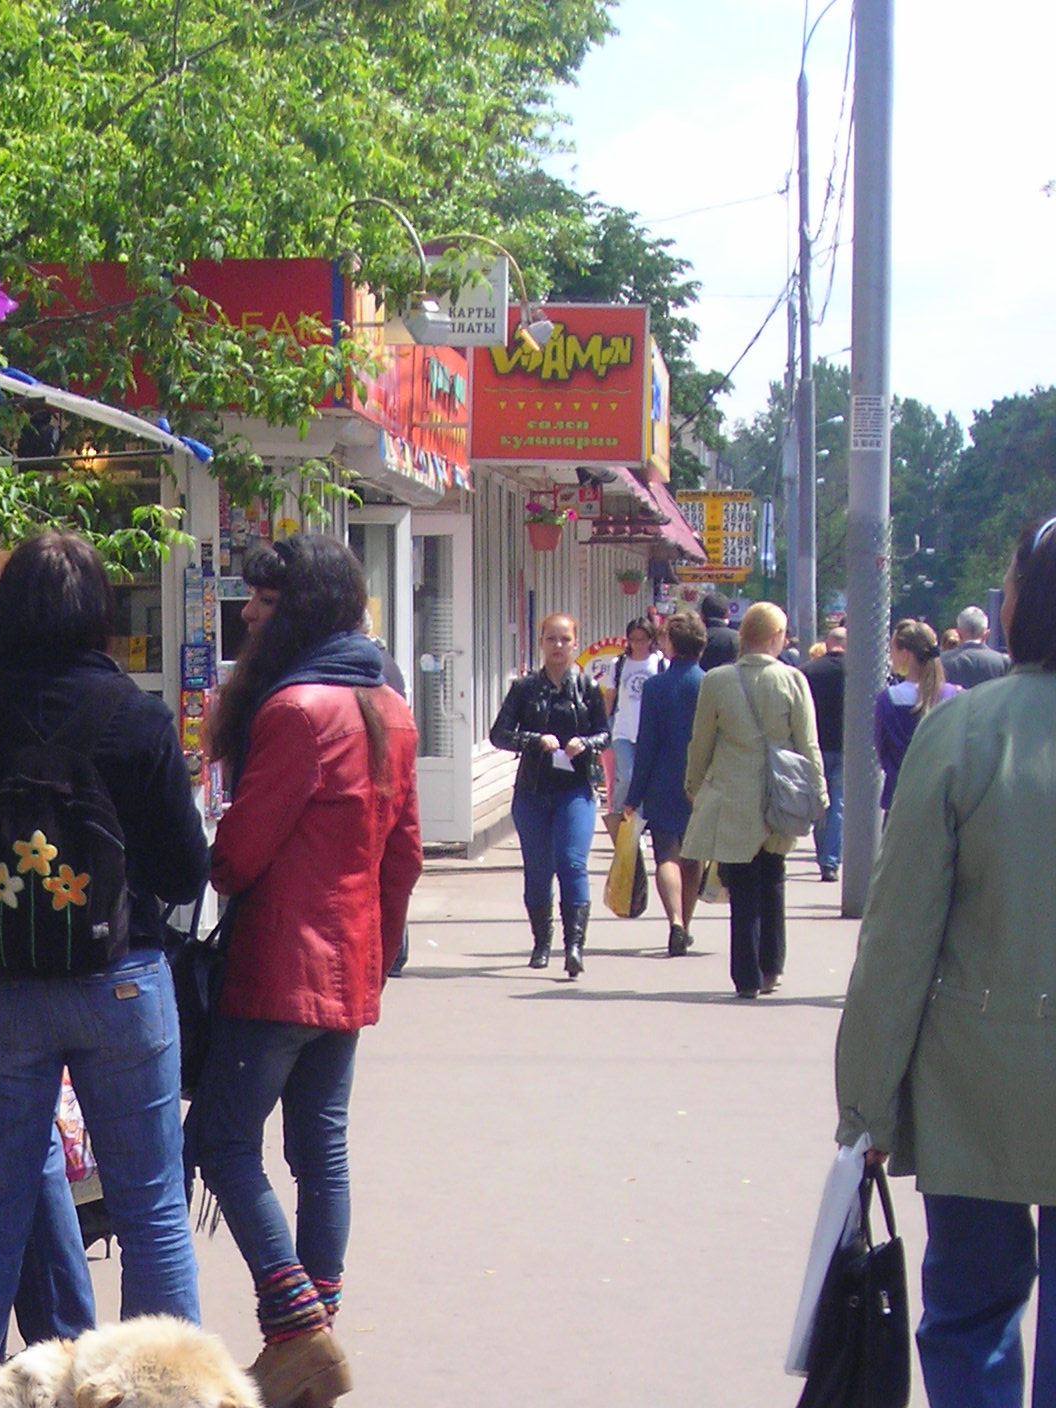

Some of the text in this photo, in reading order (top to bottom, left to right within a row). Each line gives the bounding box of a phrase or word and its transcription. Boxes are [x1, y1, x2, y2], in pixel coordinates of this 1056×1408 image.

[448, 307, 496, 318] КАРТЫ
[527, 420, 589, 430] салон
[500, 435, 619, 450] кулинарии
[723, 502, 750, 512] 2371
[723, 523, 751, 532] 4710
[723, 547, 750, 556] 2471
